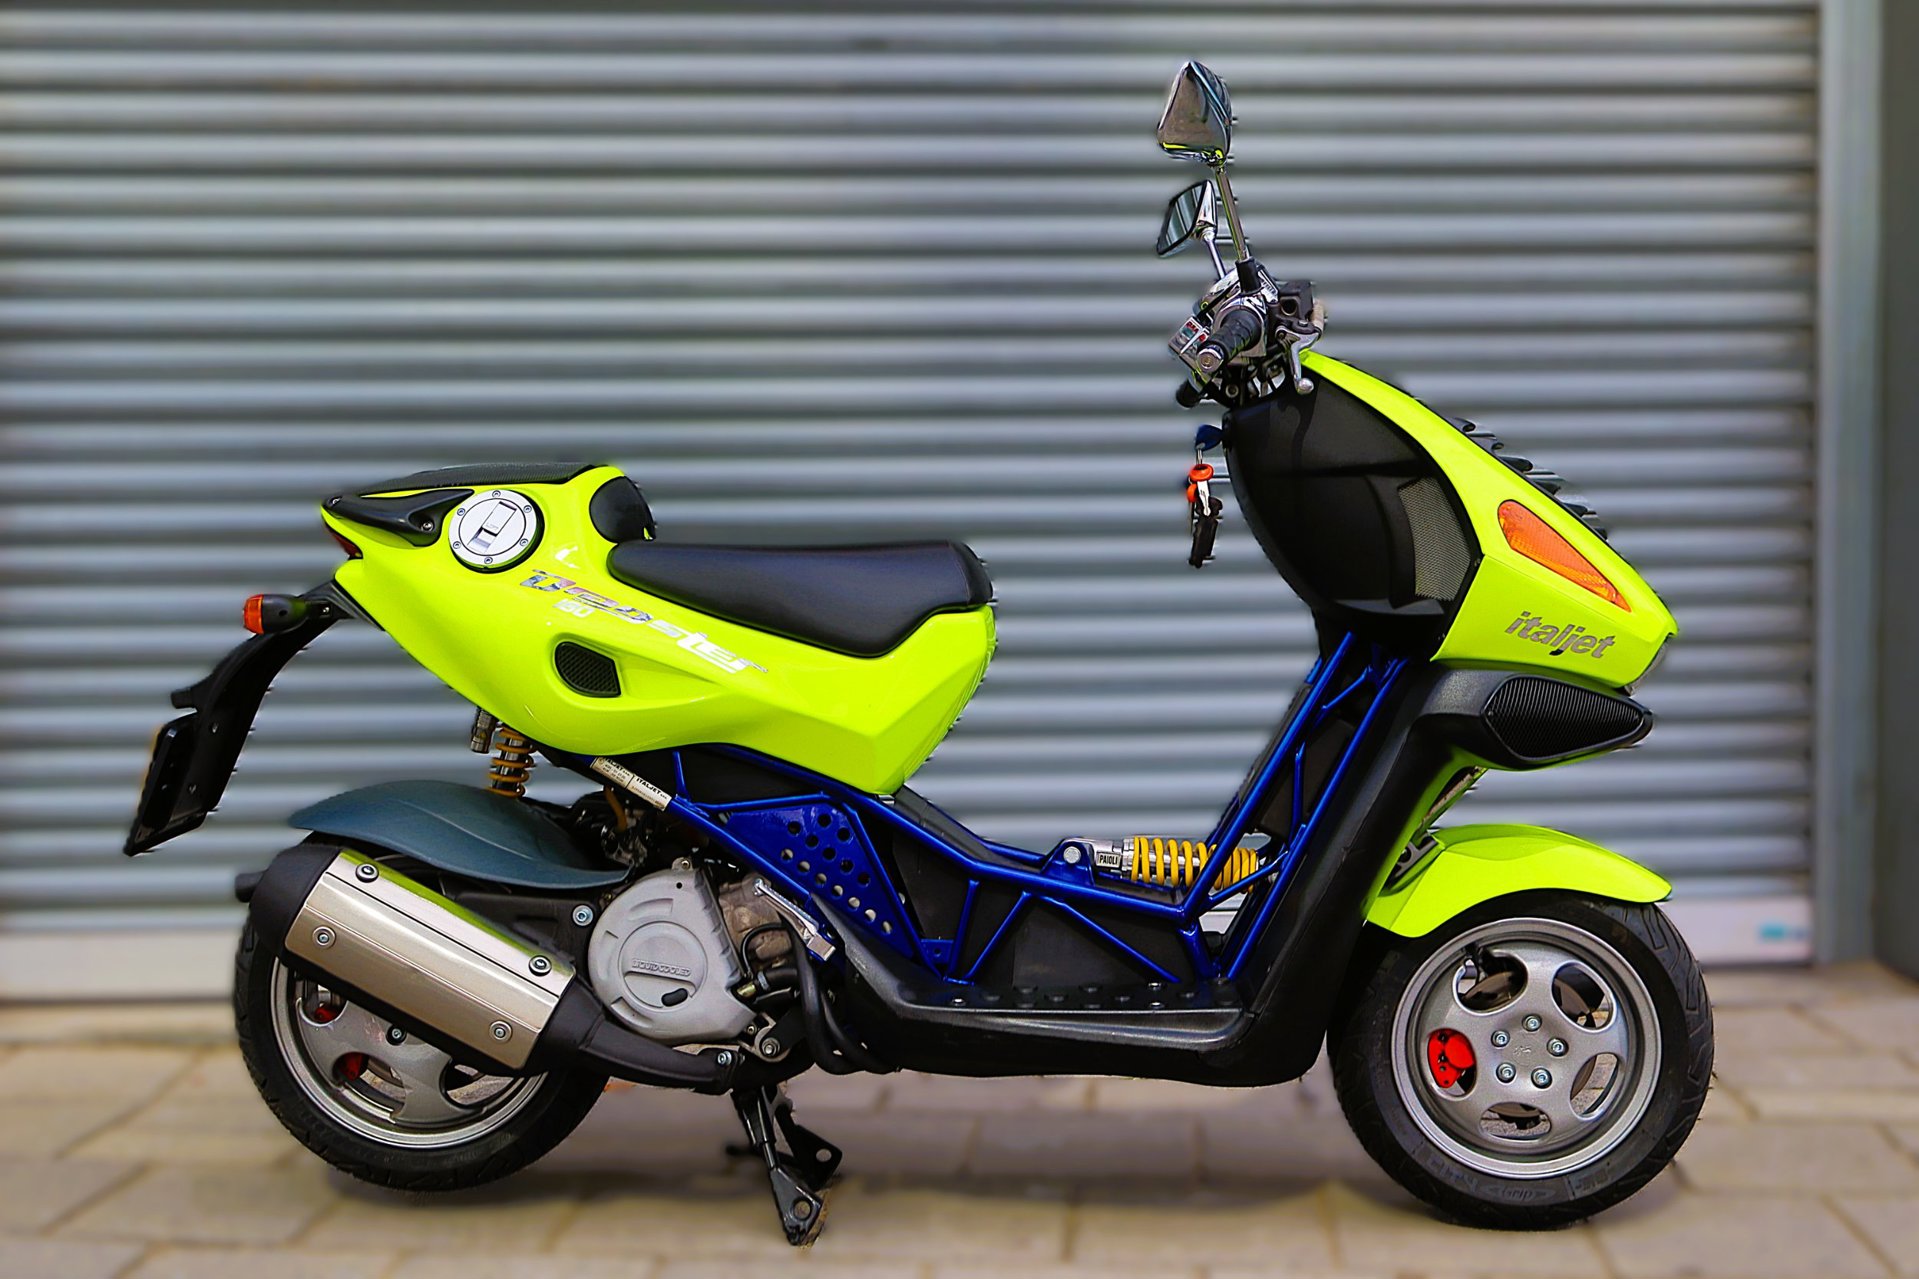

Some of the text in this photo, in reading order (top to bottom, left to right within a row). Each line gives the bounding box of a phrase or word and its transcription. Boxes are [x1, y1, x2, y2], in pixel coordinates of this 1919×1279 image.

[1504, 611, 1616, 659] italjet
[635, 777, 662, 795] ITALJET
[1100, 854, 1118, 865] PAIOLI
[631, 960, 691, 977] LIQUID COOLED
